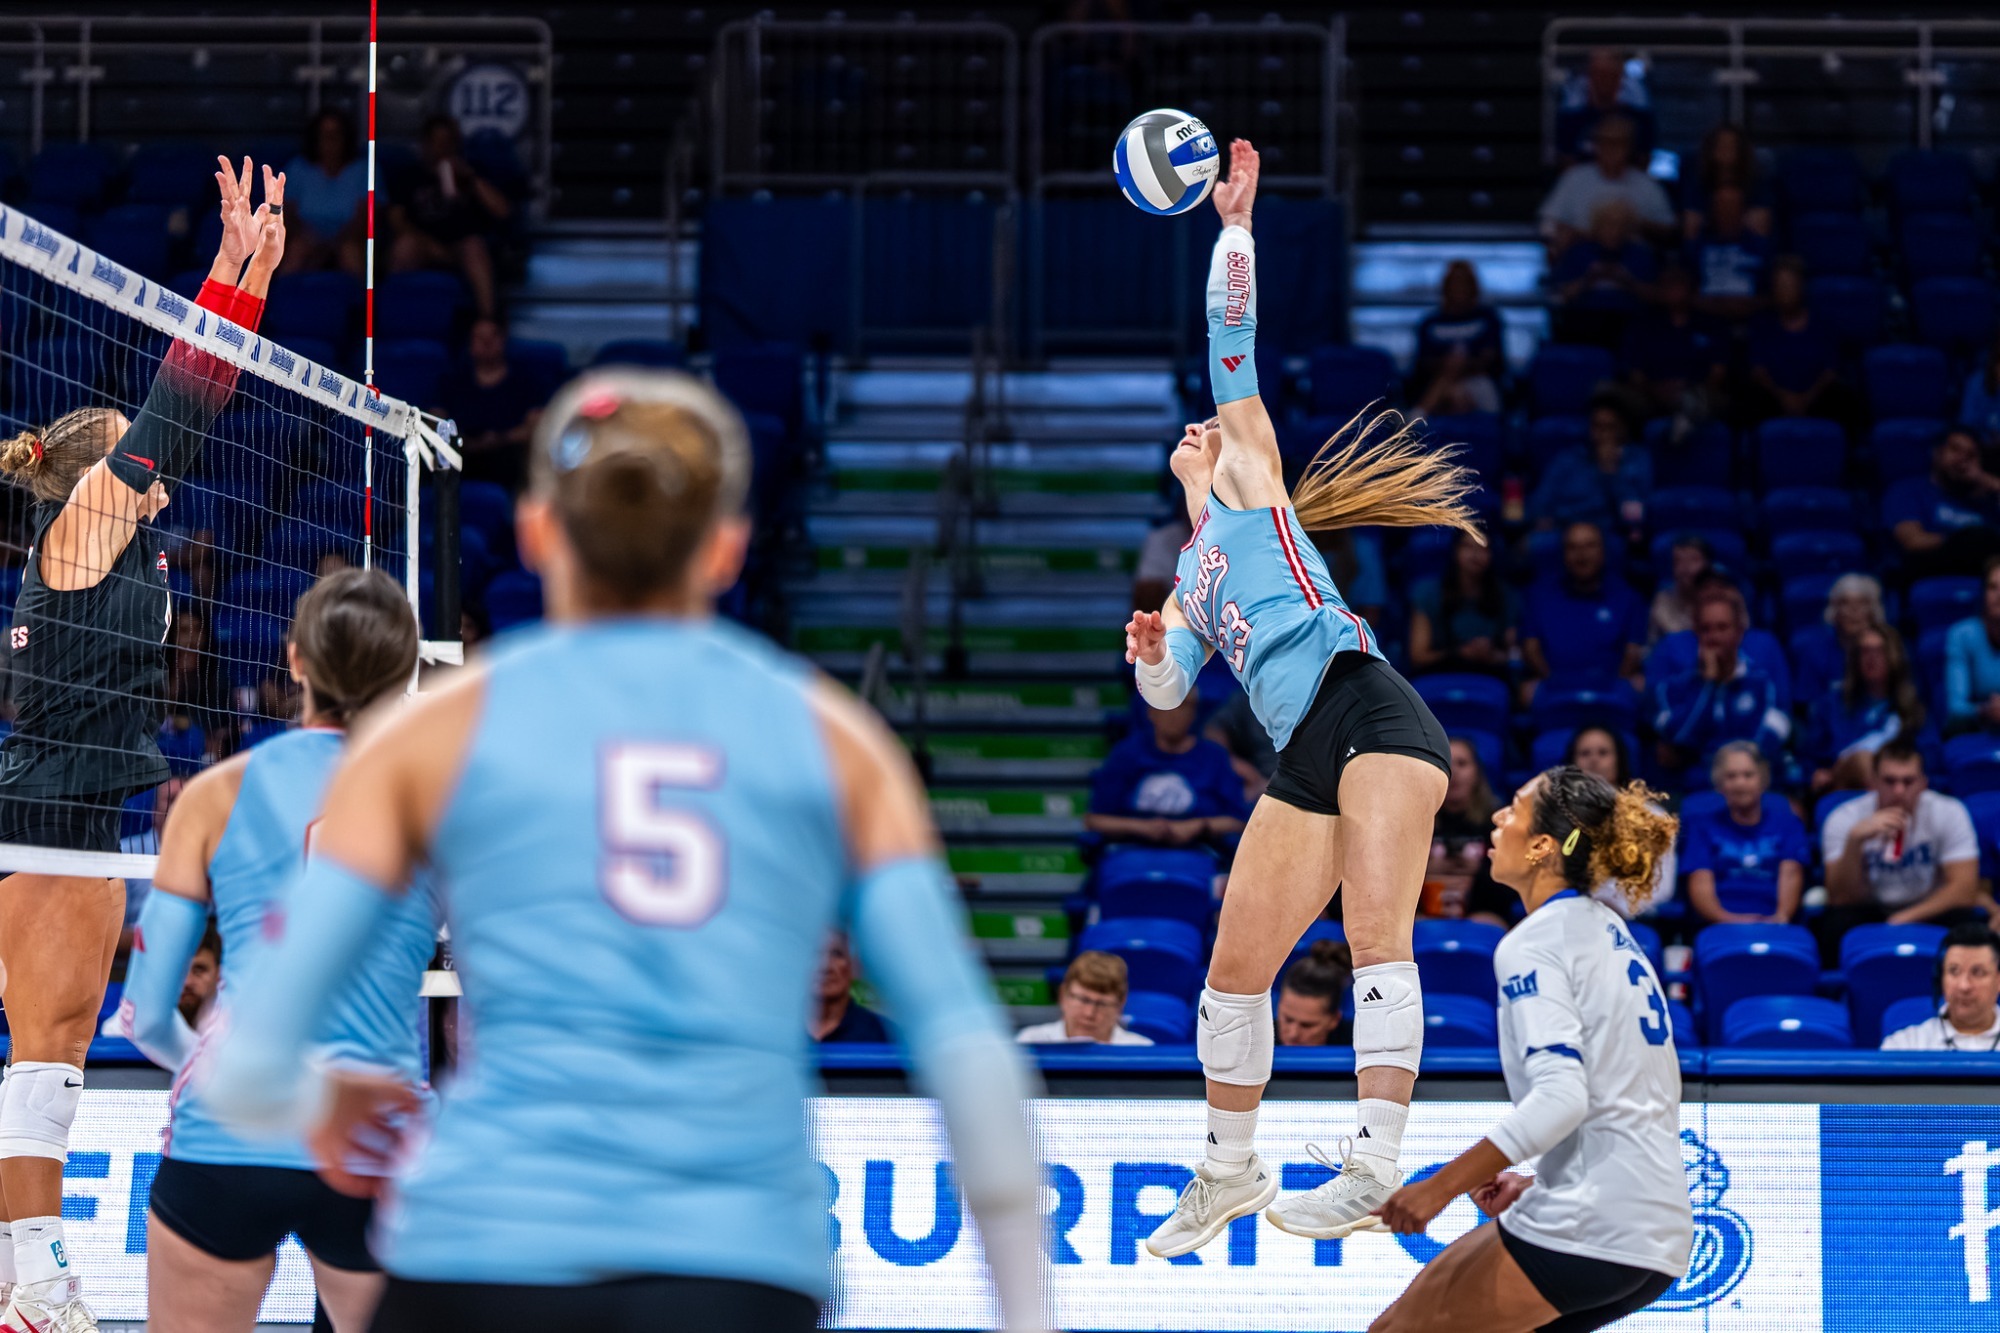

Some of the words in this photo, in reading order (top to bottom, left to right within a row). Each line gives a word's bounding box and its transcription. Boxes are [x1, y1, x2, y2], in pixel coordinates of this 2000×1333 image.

[462, 82, 519, 117] 112
[595, 738, 729, 931] 5
[1627, 959, 1669, 1046] 3
